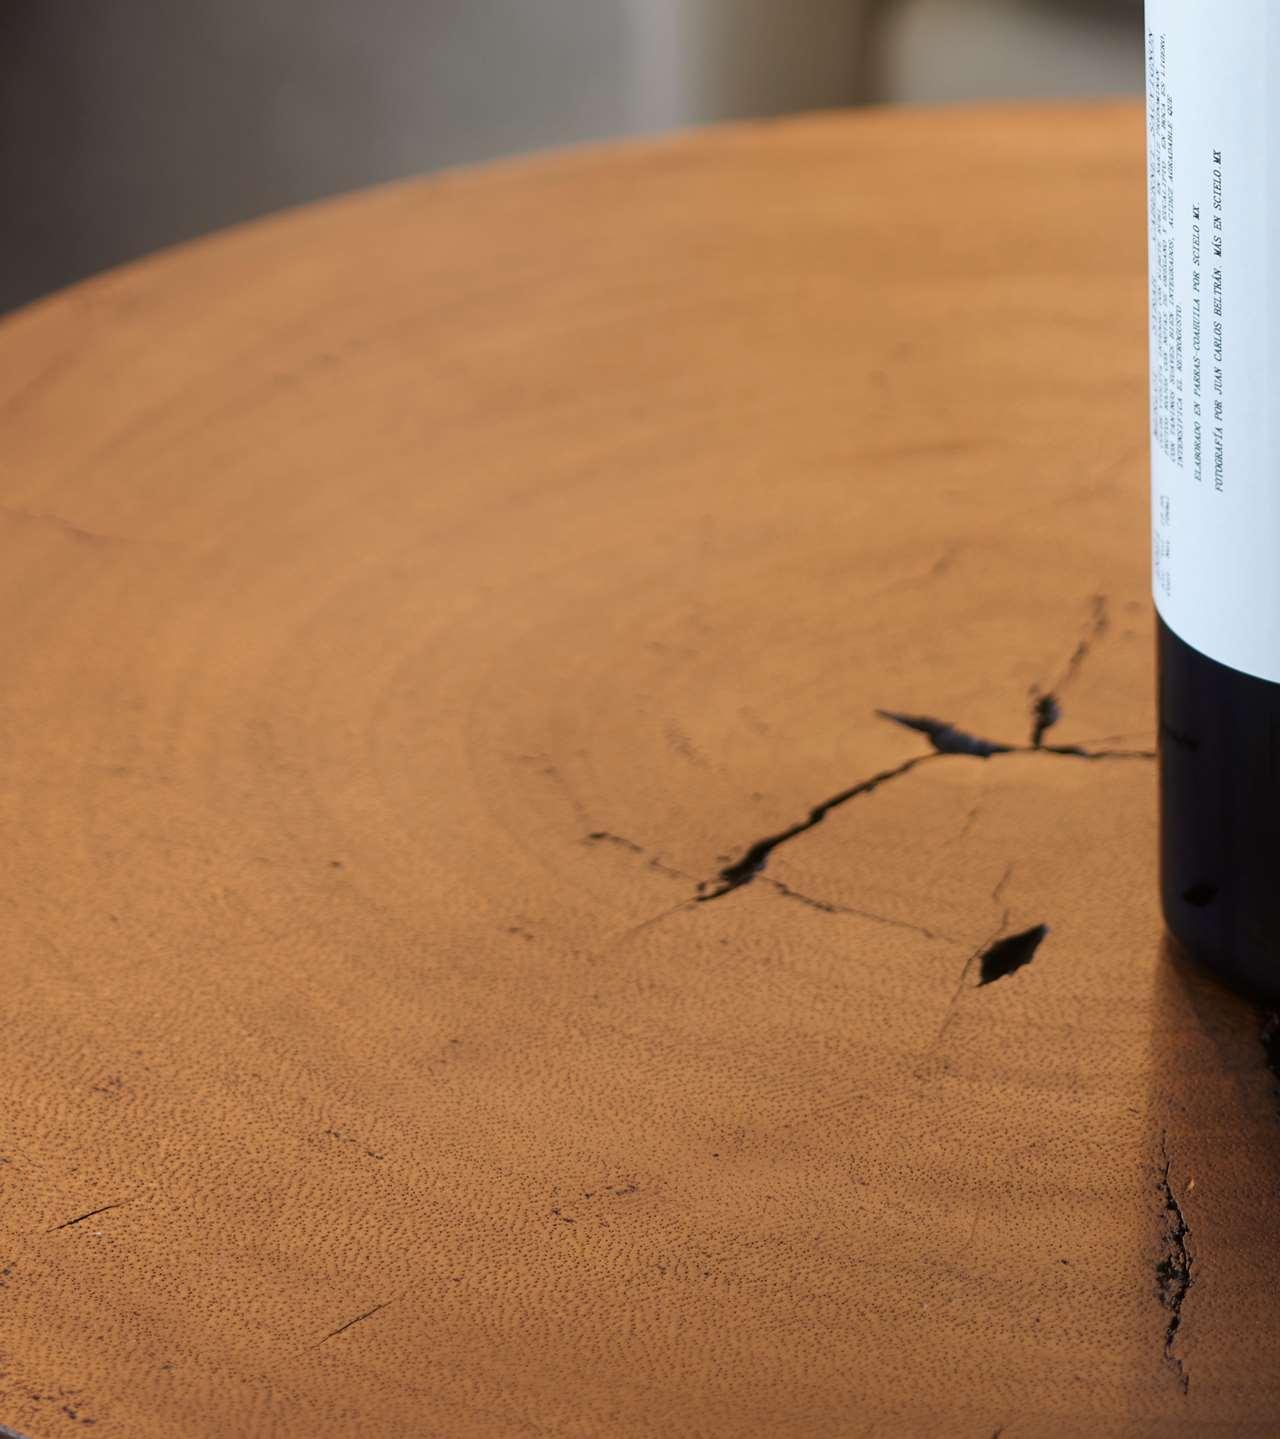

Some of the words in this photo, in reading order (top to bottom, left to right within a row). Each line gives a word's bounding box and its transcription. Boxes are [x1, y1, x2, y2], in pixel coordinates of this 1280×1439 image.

[1213, 214, 1222, 231] EN
[1192, 224, 1200, 267] SCIELO
[1211, 235, 1222, 258] MÁS
[1192, 271, 1200, 293] POR
[1213, 321, 1222, 363] CARLOS
[1176, 379, 1183, 392] EL
[1214, 366, 1223, 396] JUAN
[1194, 401, 1201, 417] EN
[1214, 400, 1223, 422] POR
[1212, 426, 1223, 494] FOTOGRAFÍA
